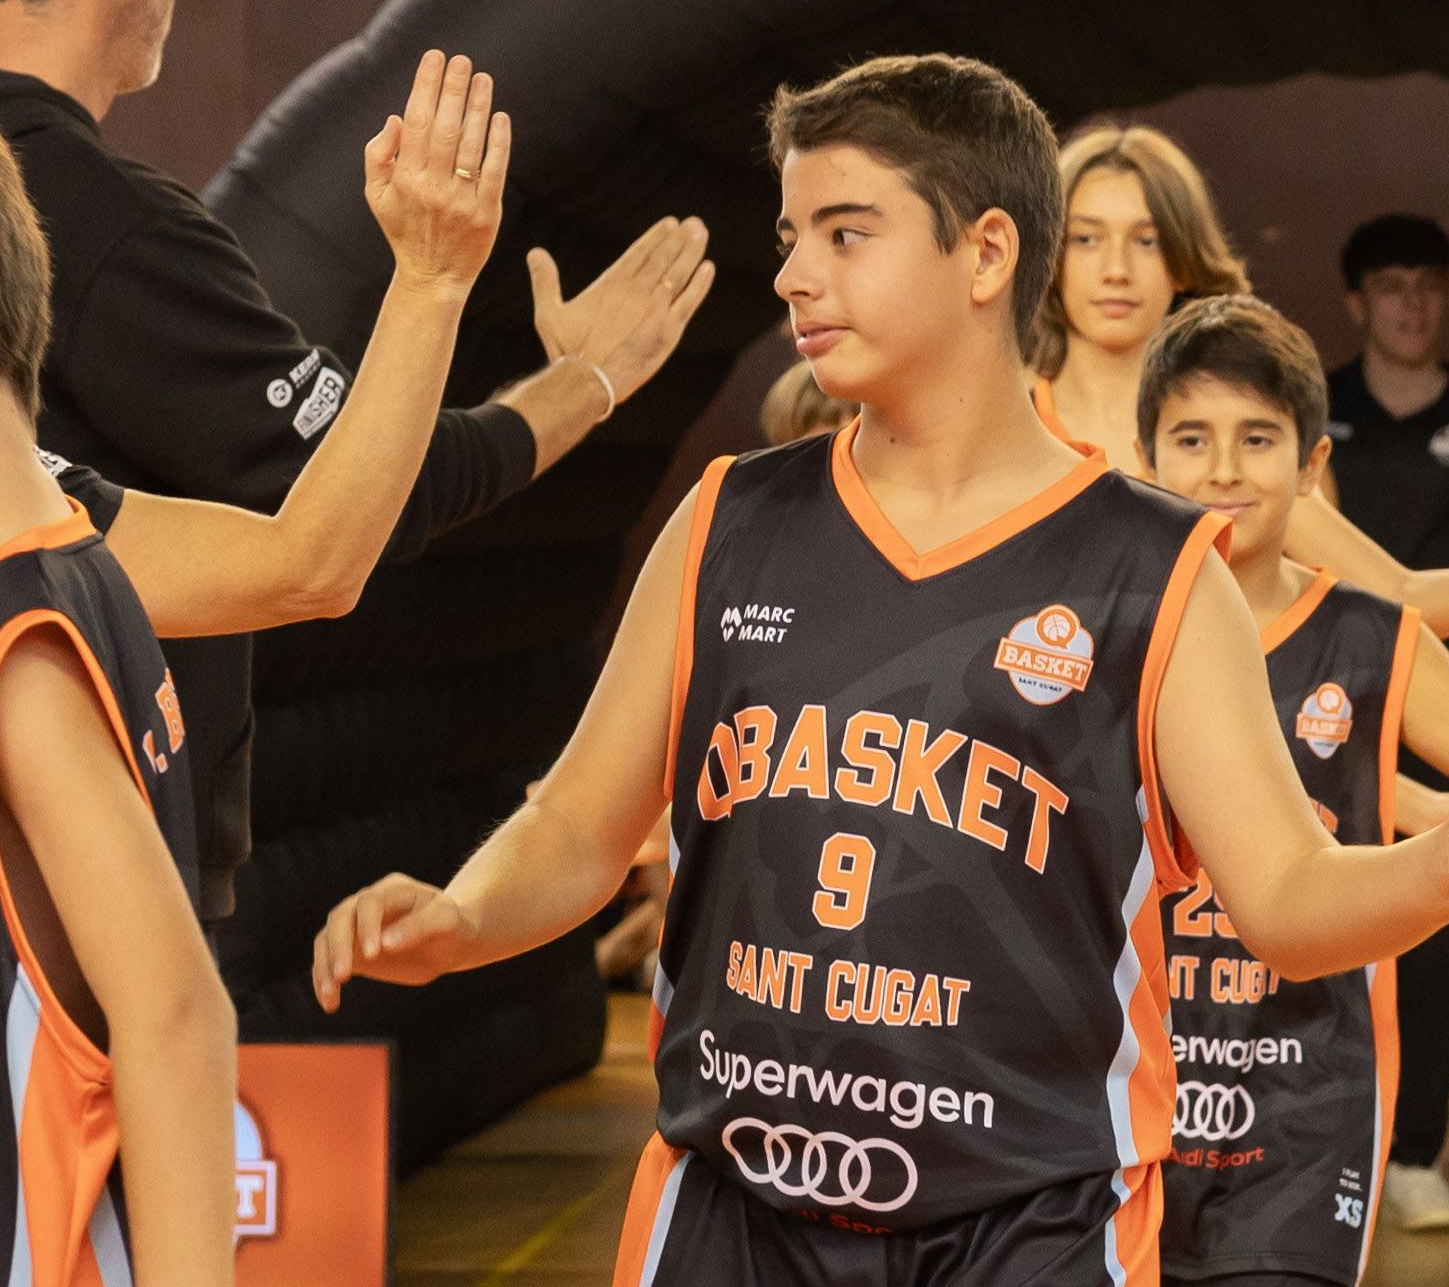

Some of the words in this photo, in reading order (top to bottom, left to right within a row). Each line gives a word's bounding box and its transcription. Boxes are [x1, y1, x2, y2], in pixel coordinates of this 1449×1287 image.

[744, 603, 796, 625] MARC
[737, 624, 788, 645] MART
[1002, 645, 1088, 682] BASKET
[812, 831, 877, 931] 9
[725, 939, 813, 1014] SANT
[824, 959, 971, 1027] CUGAT
[699, 1028, 996, 1130] Superwagen
[1206, 1146, 1264, 1171] Sport
[1334, 1193, 1364, 1229] XS
